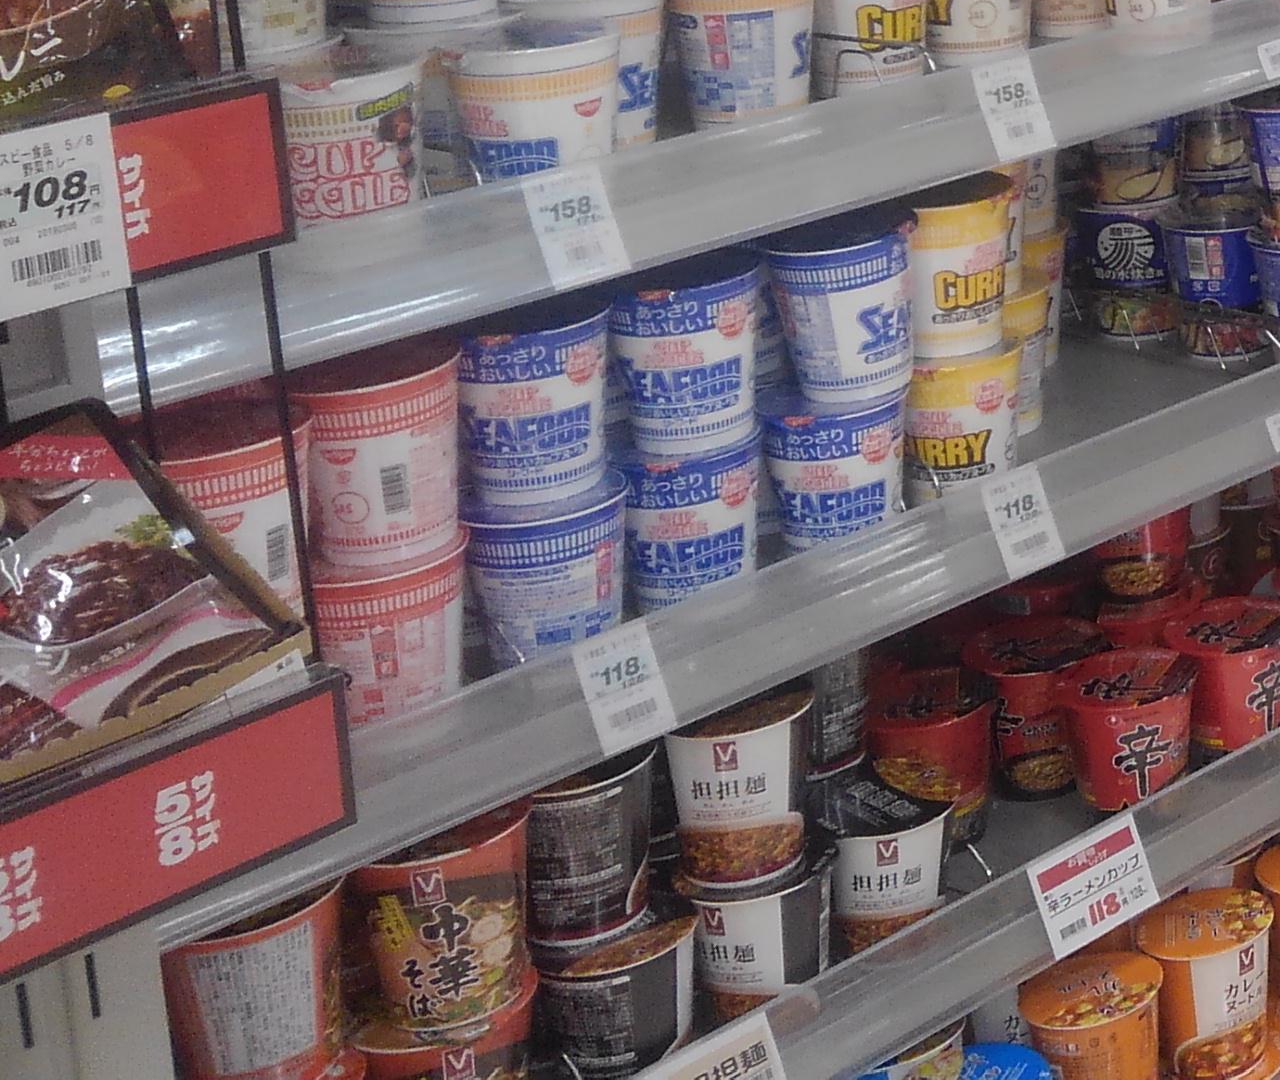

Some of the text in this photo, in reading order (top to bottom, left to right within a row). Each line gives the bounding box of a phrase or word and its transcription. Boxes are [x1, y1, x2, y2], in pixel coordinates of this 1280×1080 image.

[856, 4, 927, 52] CUR
[994, 82, 1025, 104] 158
[61, 134, 94, 153] 5/8
[21, 157, 76, 178] 野菜カレー
[13, 169, 87, 214] 108
[51, 200, 87, 219] 117
[548, 195, 592, 222] 158
[636, 300, 698, 320] あっさり
[636, 316, 705, 335] おいしい
[479, 346, 548, 367] あっさり
[479, 362, 552, 382] おいしい
[622, 353, 743, 407] EAFOOD
[464, 400, 592, 455] EAFOOD
[787, 429, 844, 447] あっさり
[787, 442, 850, 460] おいしい
[641, 472, 705, 491] あっさり
[641, 487, 709, 508] おいしい
[770, 478, 885, 525] EAFOOD
[1003, 494, 1034, 519] 118
[626, 522, 745, 576] EAFOOD
[600, 656, 642, 687] 118
[1112, 722, 1175, 800] 辛
[691, 773, 768, 801] 担担麺
[851, 864, 923, 893] 担担麺
[1046, 852, 1142, 915] 辛ラーメンカップ
[1087, 889, 1123, 926] 118
[422, 903, 480, 1000] 中華
[400, 959, 443, 1019] そば
[1224, 971, 1265, 1000] カレー
